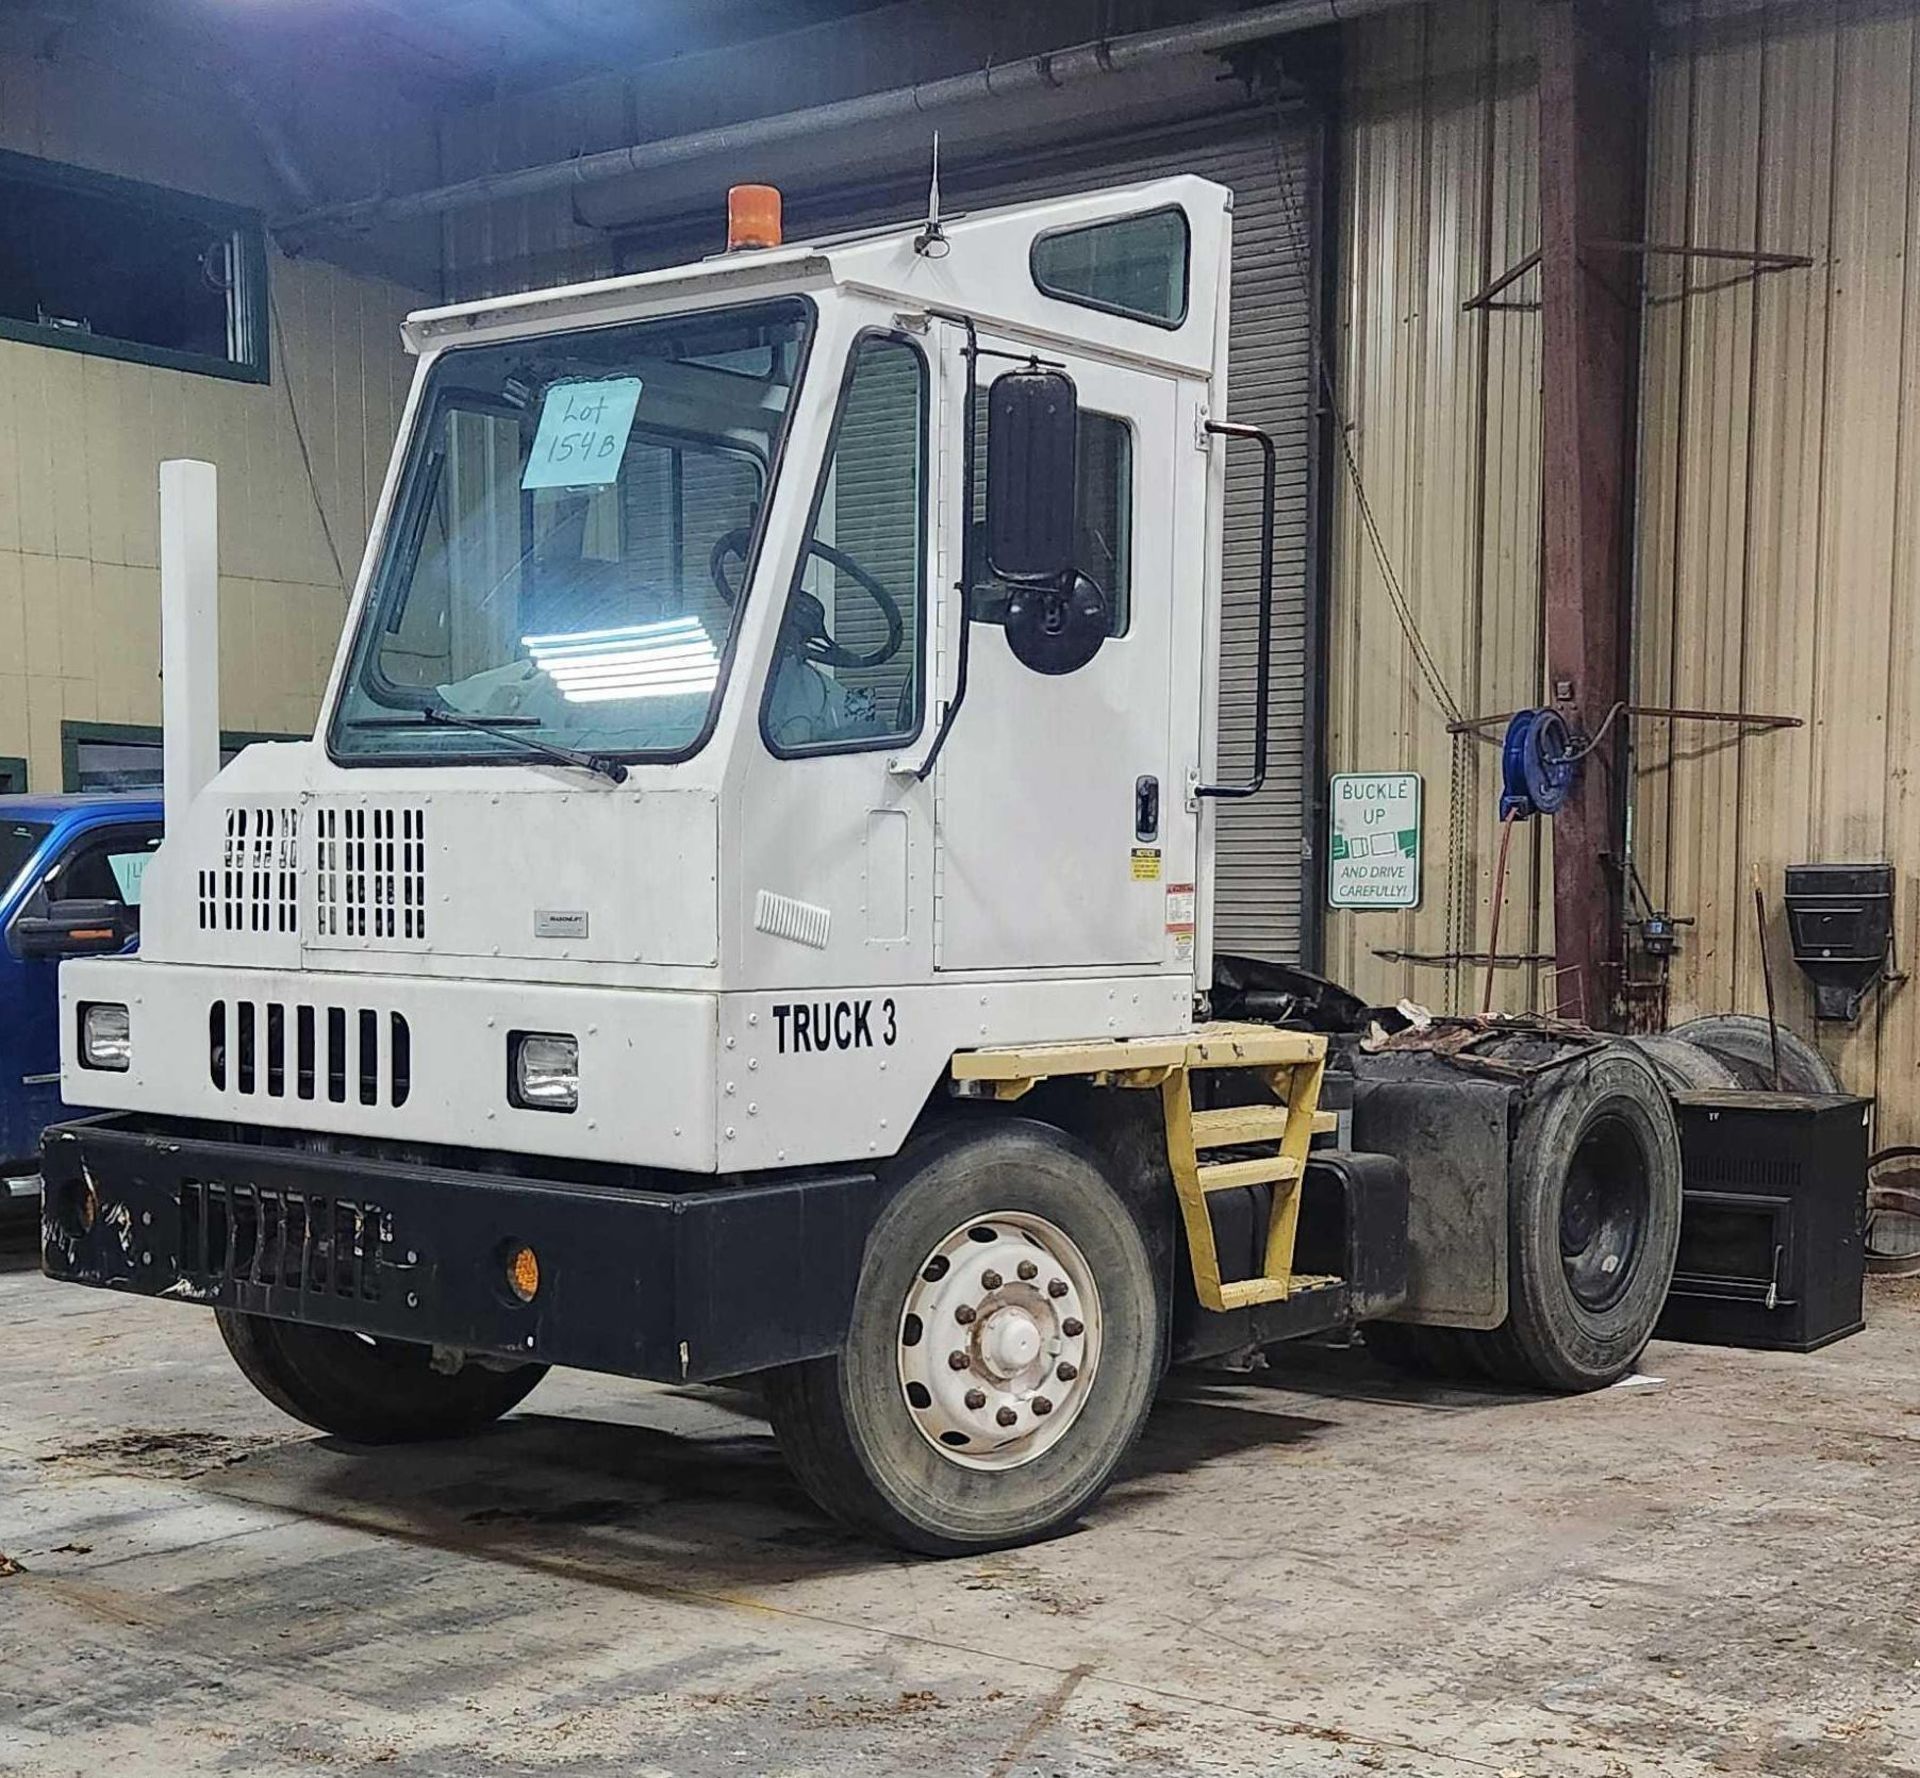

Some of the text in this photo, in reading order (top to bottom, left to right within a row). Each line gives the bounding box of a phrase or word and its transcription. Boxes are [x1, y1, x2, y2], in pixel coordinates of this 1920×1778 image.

[562, 395, 609, 425] Lot
[547, 431, 616, 463] 154B
[1342, 783, 1408, 800] BUCKLE
[1363, 808, 1386, 825] UP
[1340, 865, 1406, 879] AND DRIVE
[1339, 885, 1408, 897] CAREFULLY!
[772, 998, 897, 1054] TRUCK 3
